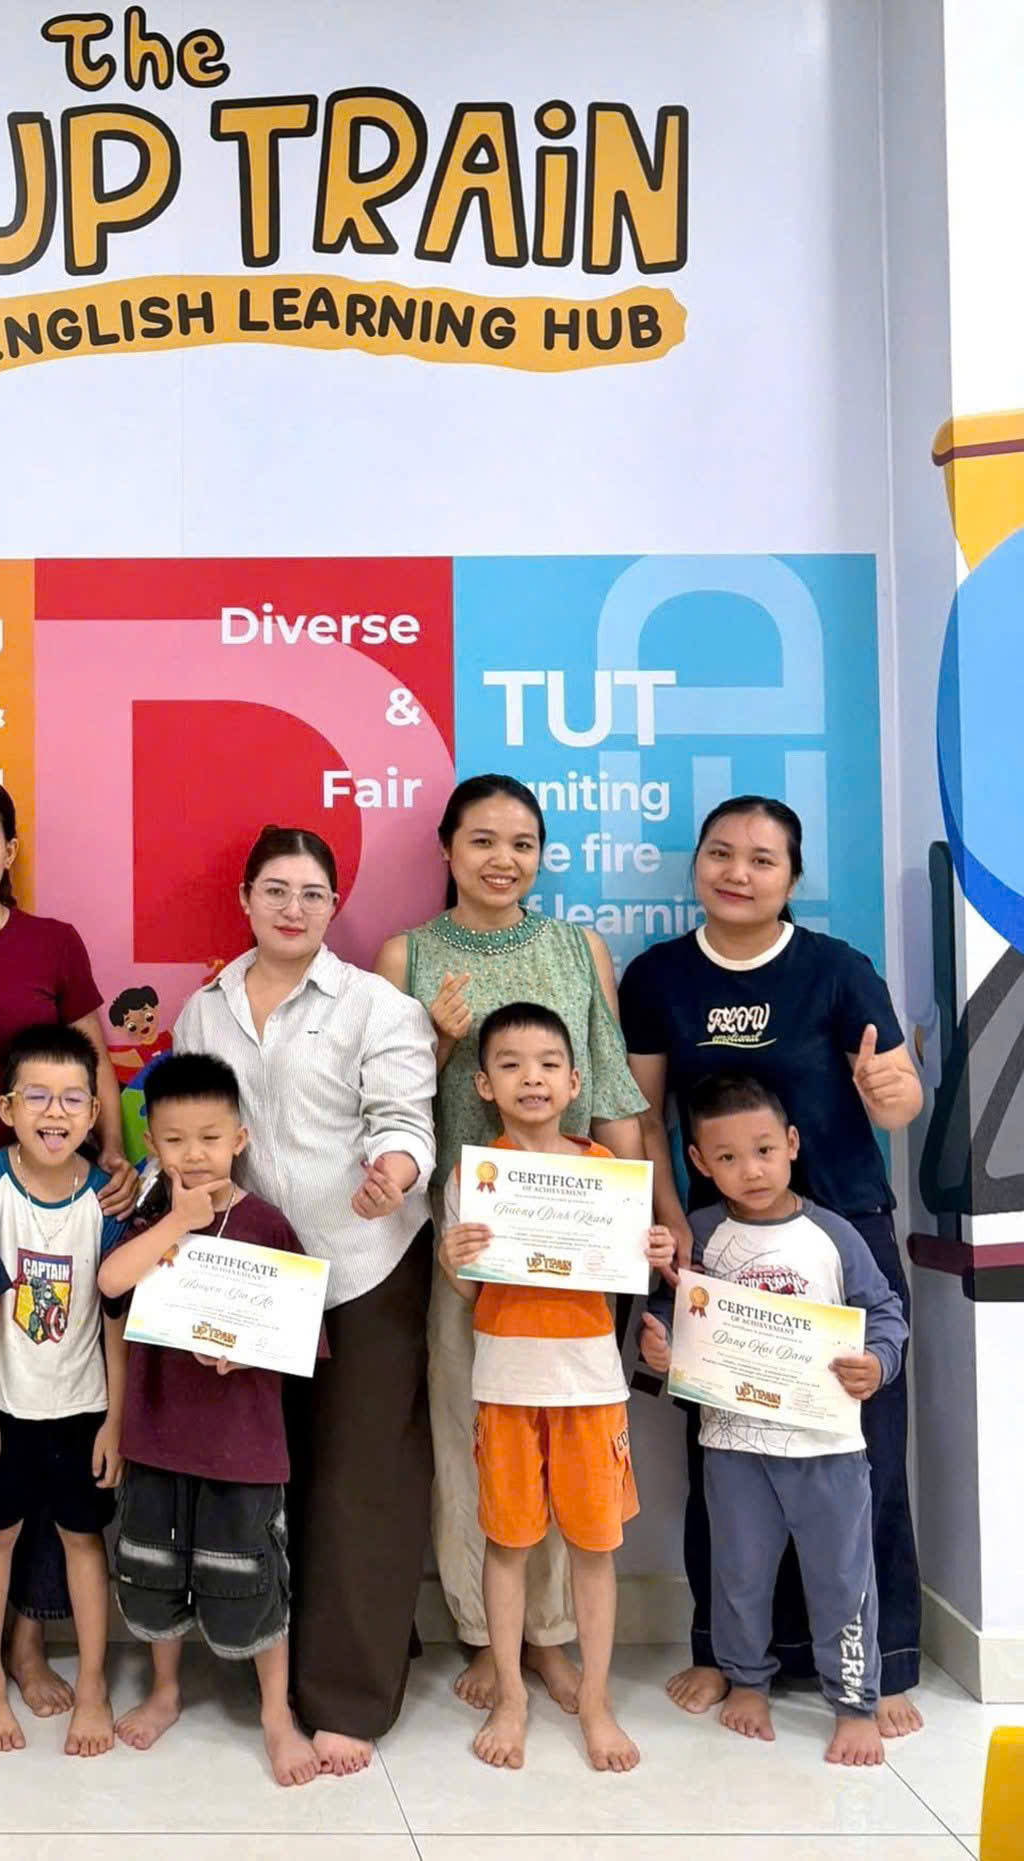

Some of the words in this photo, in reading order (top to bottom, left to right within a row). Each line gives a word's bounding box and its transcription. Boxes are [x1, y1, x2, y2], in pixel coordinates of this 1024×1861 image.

[41, 6, 230, 92] The
[239, 287, 516, 350] LEARNING
[544, 304, 662, 351] HUB
[220, 604, 420, 645] Diverse
[385, 687, 422, 727] &
[483, 670, 676, 747] TUT
[322, 767, 422, 809] Fair
[527, 771, 671, 822] niting
[581, 832, 662, 874] fire
[507, 1170, 604, 1191] CERTIFICATE
[23, 1258, 70, 1281] CAPTAIN
[187, 1250, 279, 1278] CERTIFICATE
[717, 1299, 813, 1332] CERTIFICATE
[712, 1329, 746, 1349] Dang
[775, 1346, 814, 1364] Dang
